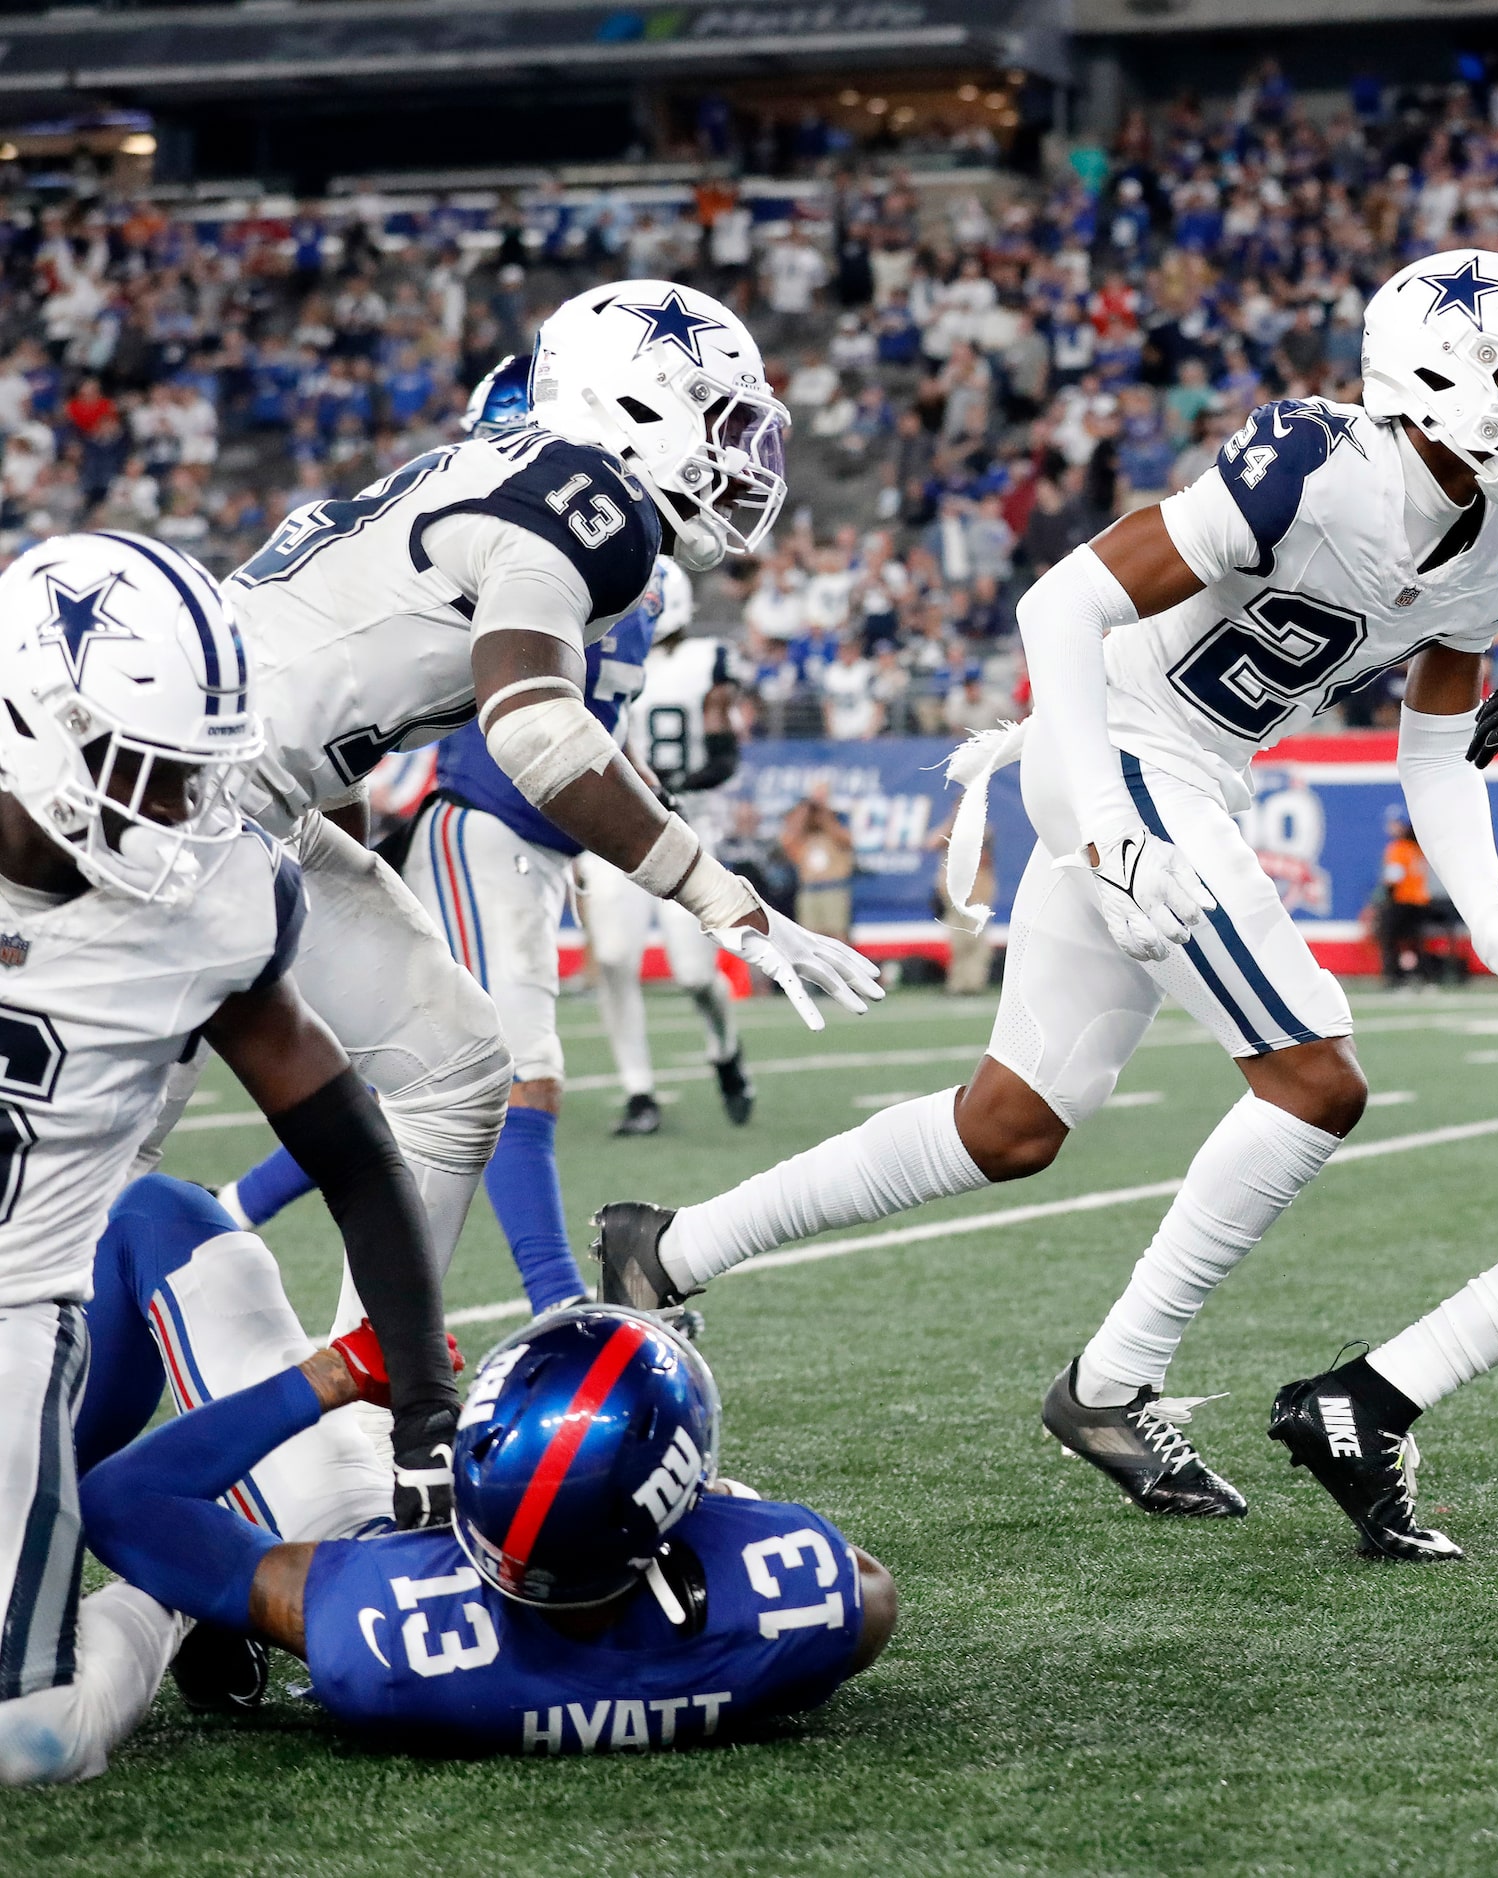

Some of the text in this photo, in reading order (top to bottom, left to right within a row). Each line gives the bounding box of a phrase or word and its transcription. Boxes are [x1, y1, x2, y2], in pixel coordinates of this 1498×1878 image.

[1223, 415, 1279, 490] 24
[544, 472, 626, 549] 13
[1166, 586, 1400, 743] 2
[1317, 1395, 1363, 1458] NIKE
[390, 1566, 500, 1678] 13
[742, 1528, 844, 1640] 13
[522, 1691, 732, 1754] HYATT
